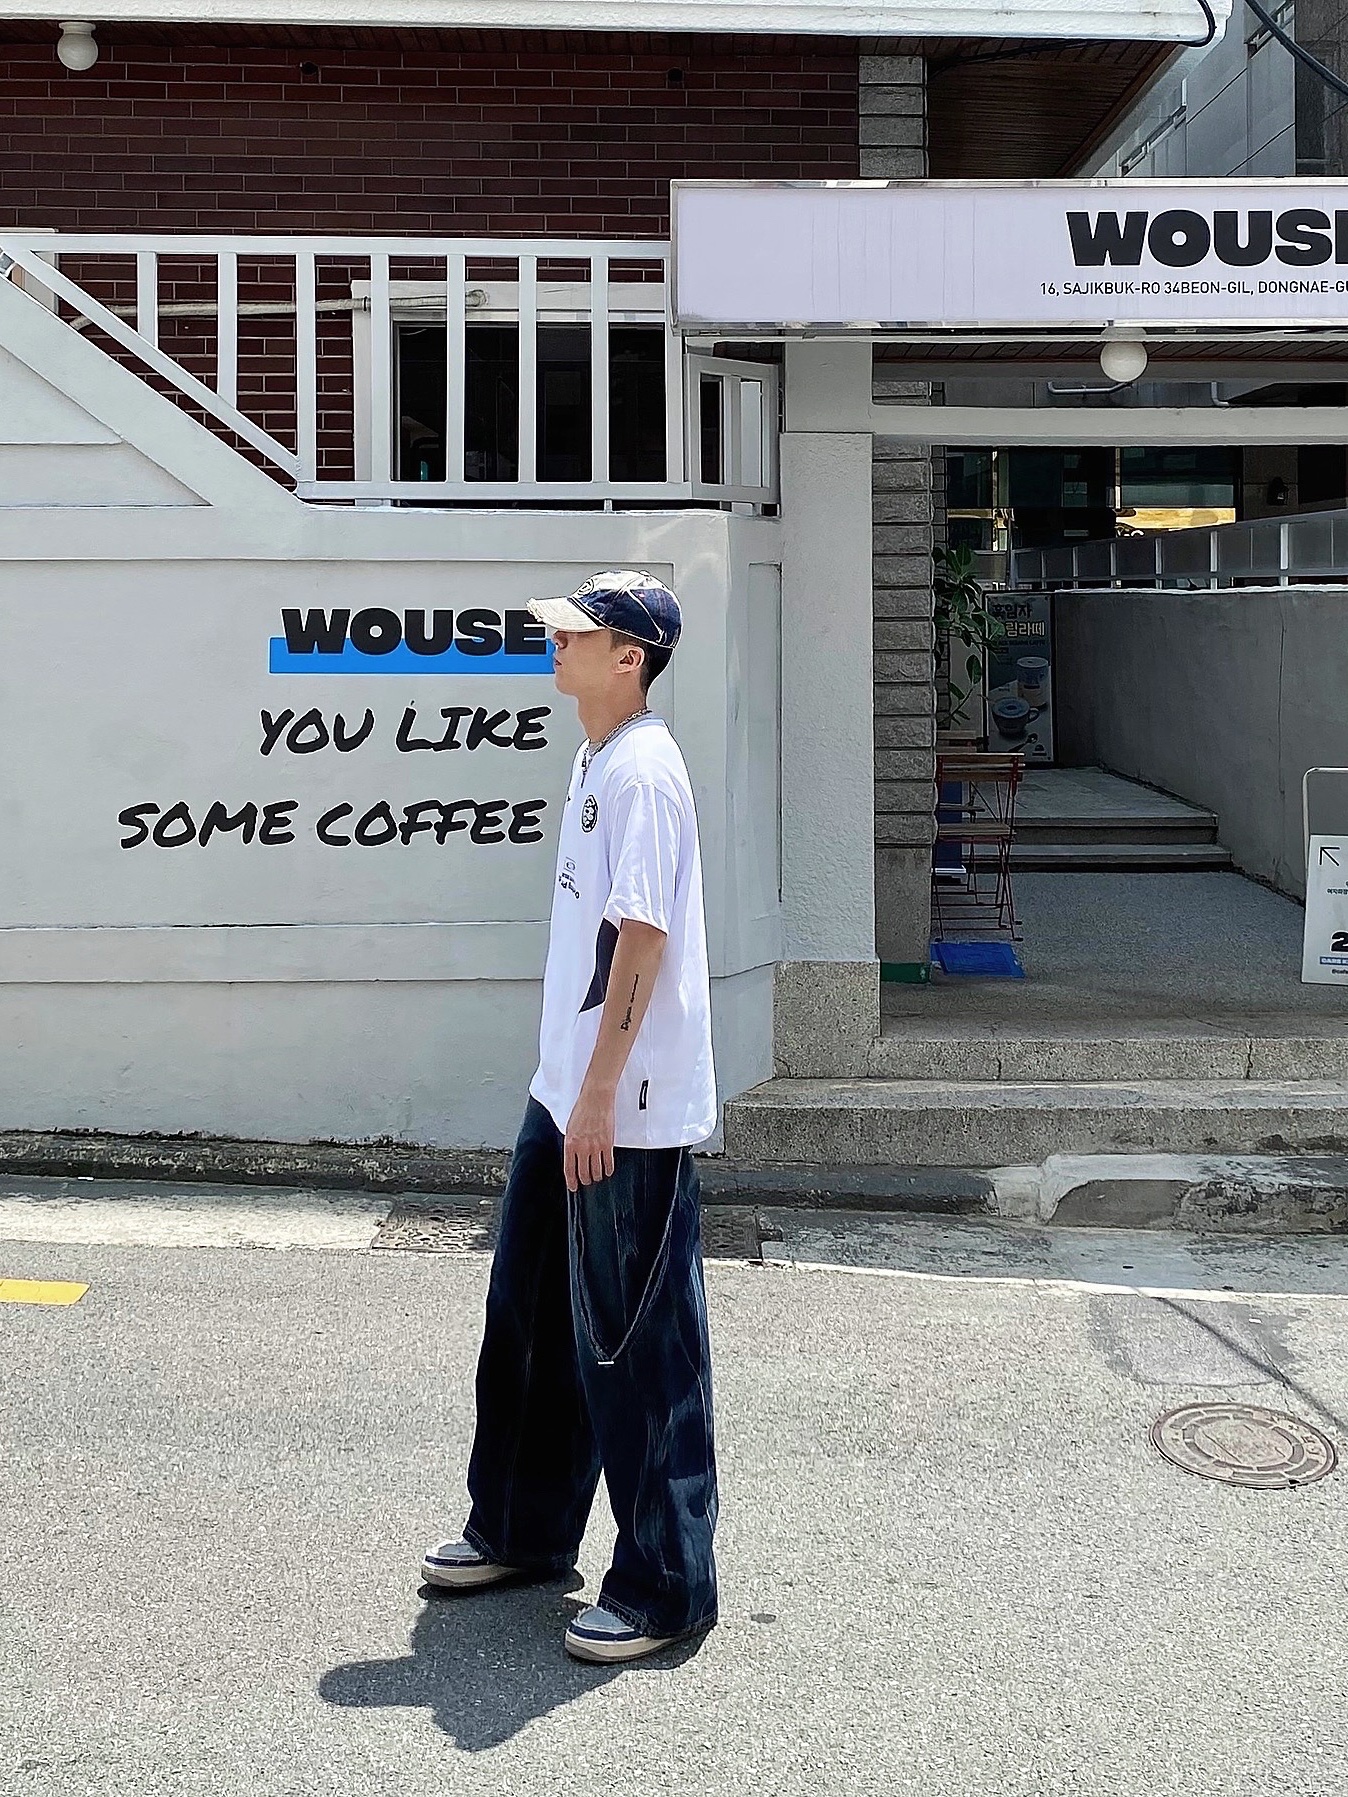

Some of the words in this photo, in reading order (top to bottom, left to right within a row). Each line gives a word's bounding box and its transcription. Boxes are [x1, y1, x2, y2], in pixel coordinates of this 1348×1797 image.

[1066, 209, 1348, 267] WOUS
[1040, 282, 1060, 296] 16,
[1063, 282, 1160, 295] SAJIKBUK-RO
[1164, 281, 1254, 295] 34BEON-GIL,
[1259, 281, 1348, 293] DONGNAE-G
[282, 609, 546, 655] WOUSE
[1005, 620, 1046, 638] 림라떼
[260, 708, 373, 756] YOU
[396, 706, 551, 752] LIKE
[118, 802, 299, 849] SOME
[316, 801, 547, 847] COFFEE
